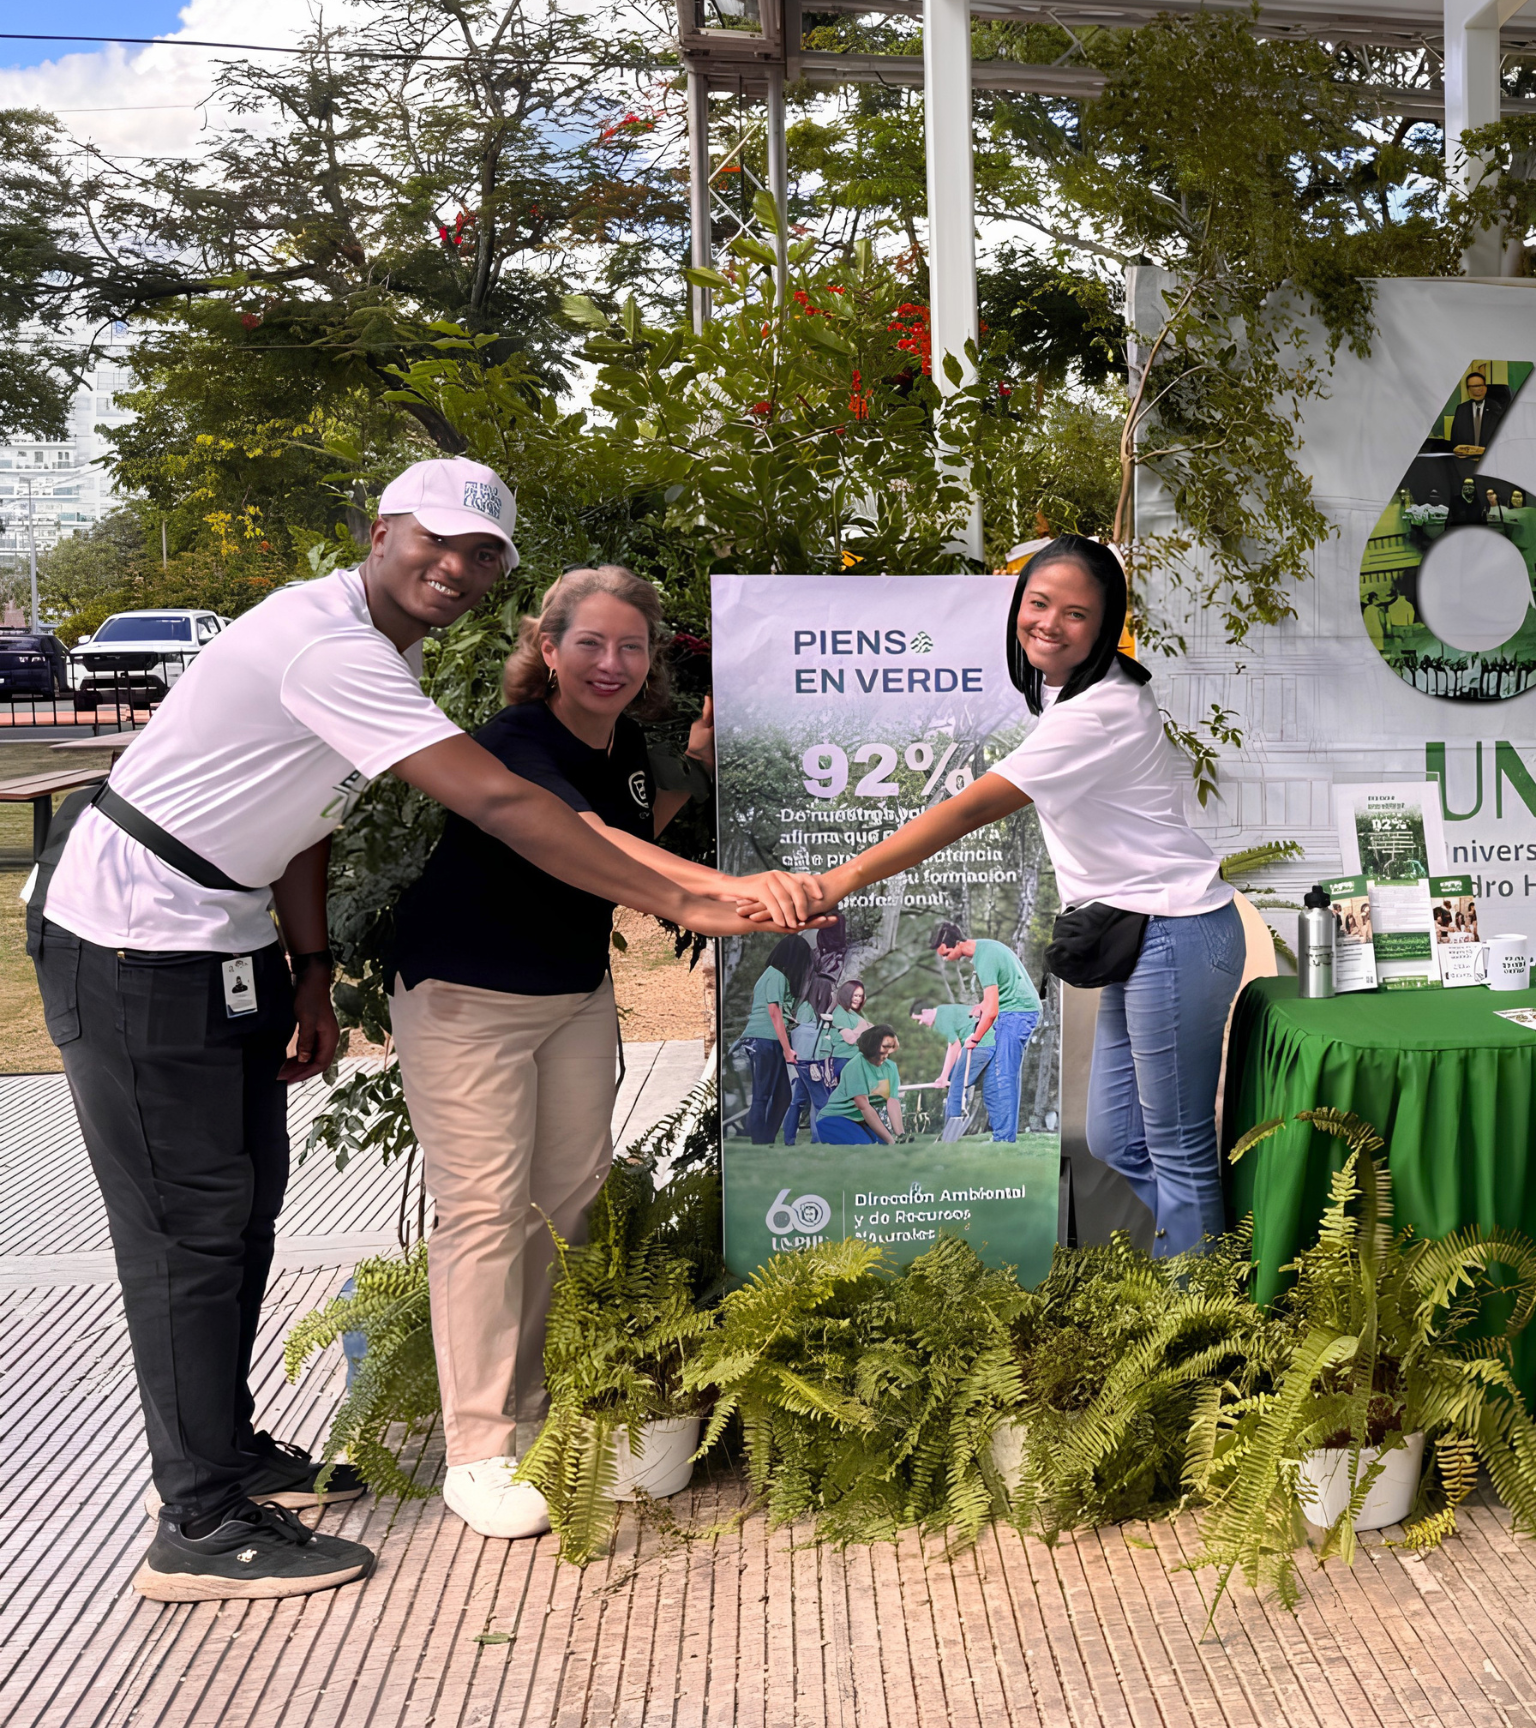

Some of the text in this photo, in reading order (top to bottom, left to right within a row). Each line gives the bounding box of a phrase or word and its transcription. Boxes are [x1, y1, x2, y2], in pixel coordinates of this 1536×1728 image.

[794, 668, 984, 694] EN VERDE
[802, 742, 974, 798] 92%
[854, 1213, 863, 1229] y
